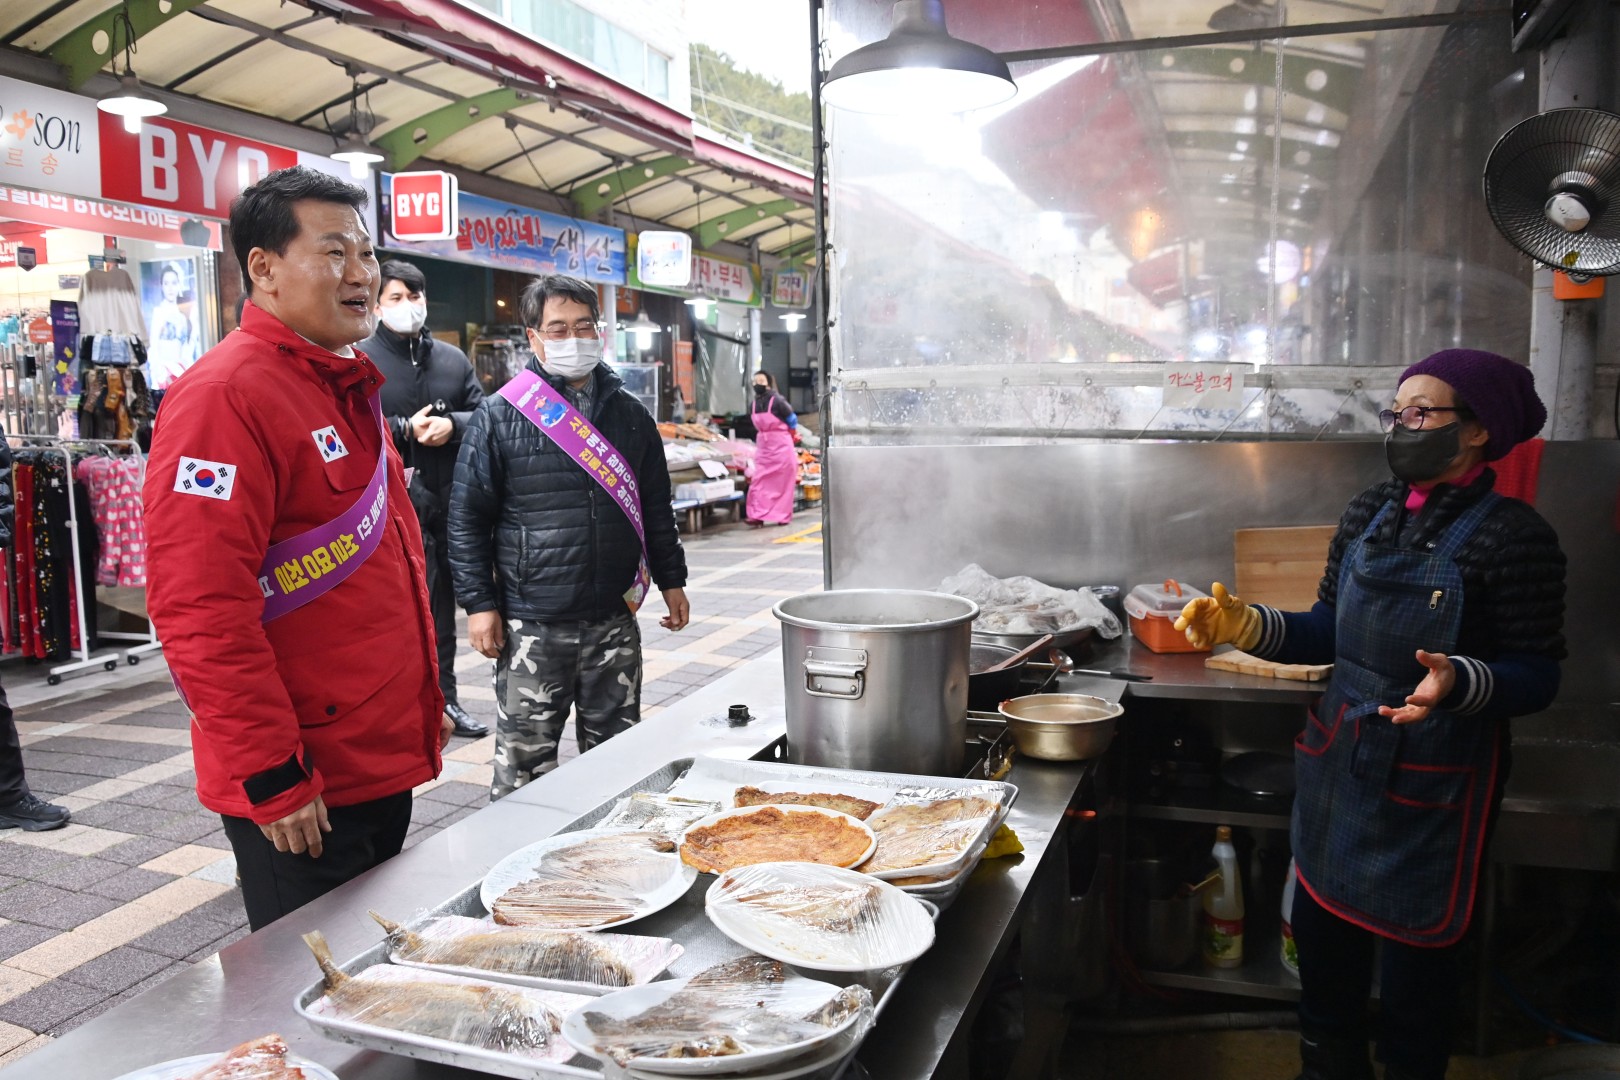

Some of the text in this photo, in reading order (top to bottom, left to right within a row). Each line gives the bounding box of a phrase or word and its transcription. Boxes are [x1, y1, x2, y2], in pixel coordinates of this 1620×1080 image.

[396, 192, 440, 218] BYC
[456, 214, 543, 251] 살아있네!
[551, 227, 615, 275] 생선
[1168, 370, 1206, 394] 가스불
[569, 415, 609, 457] 시장에서
[578, 447, 619, 488] 전통시장
